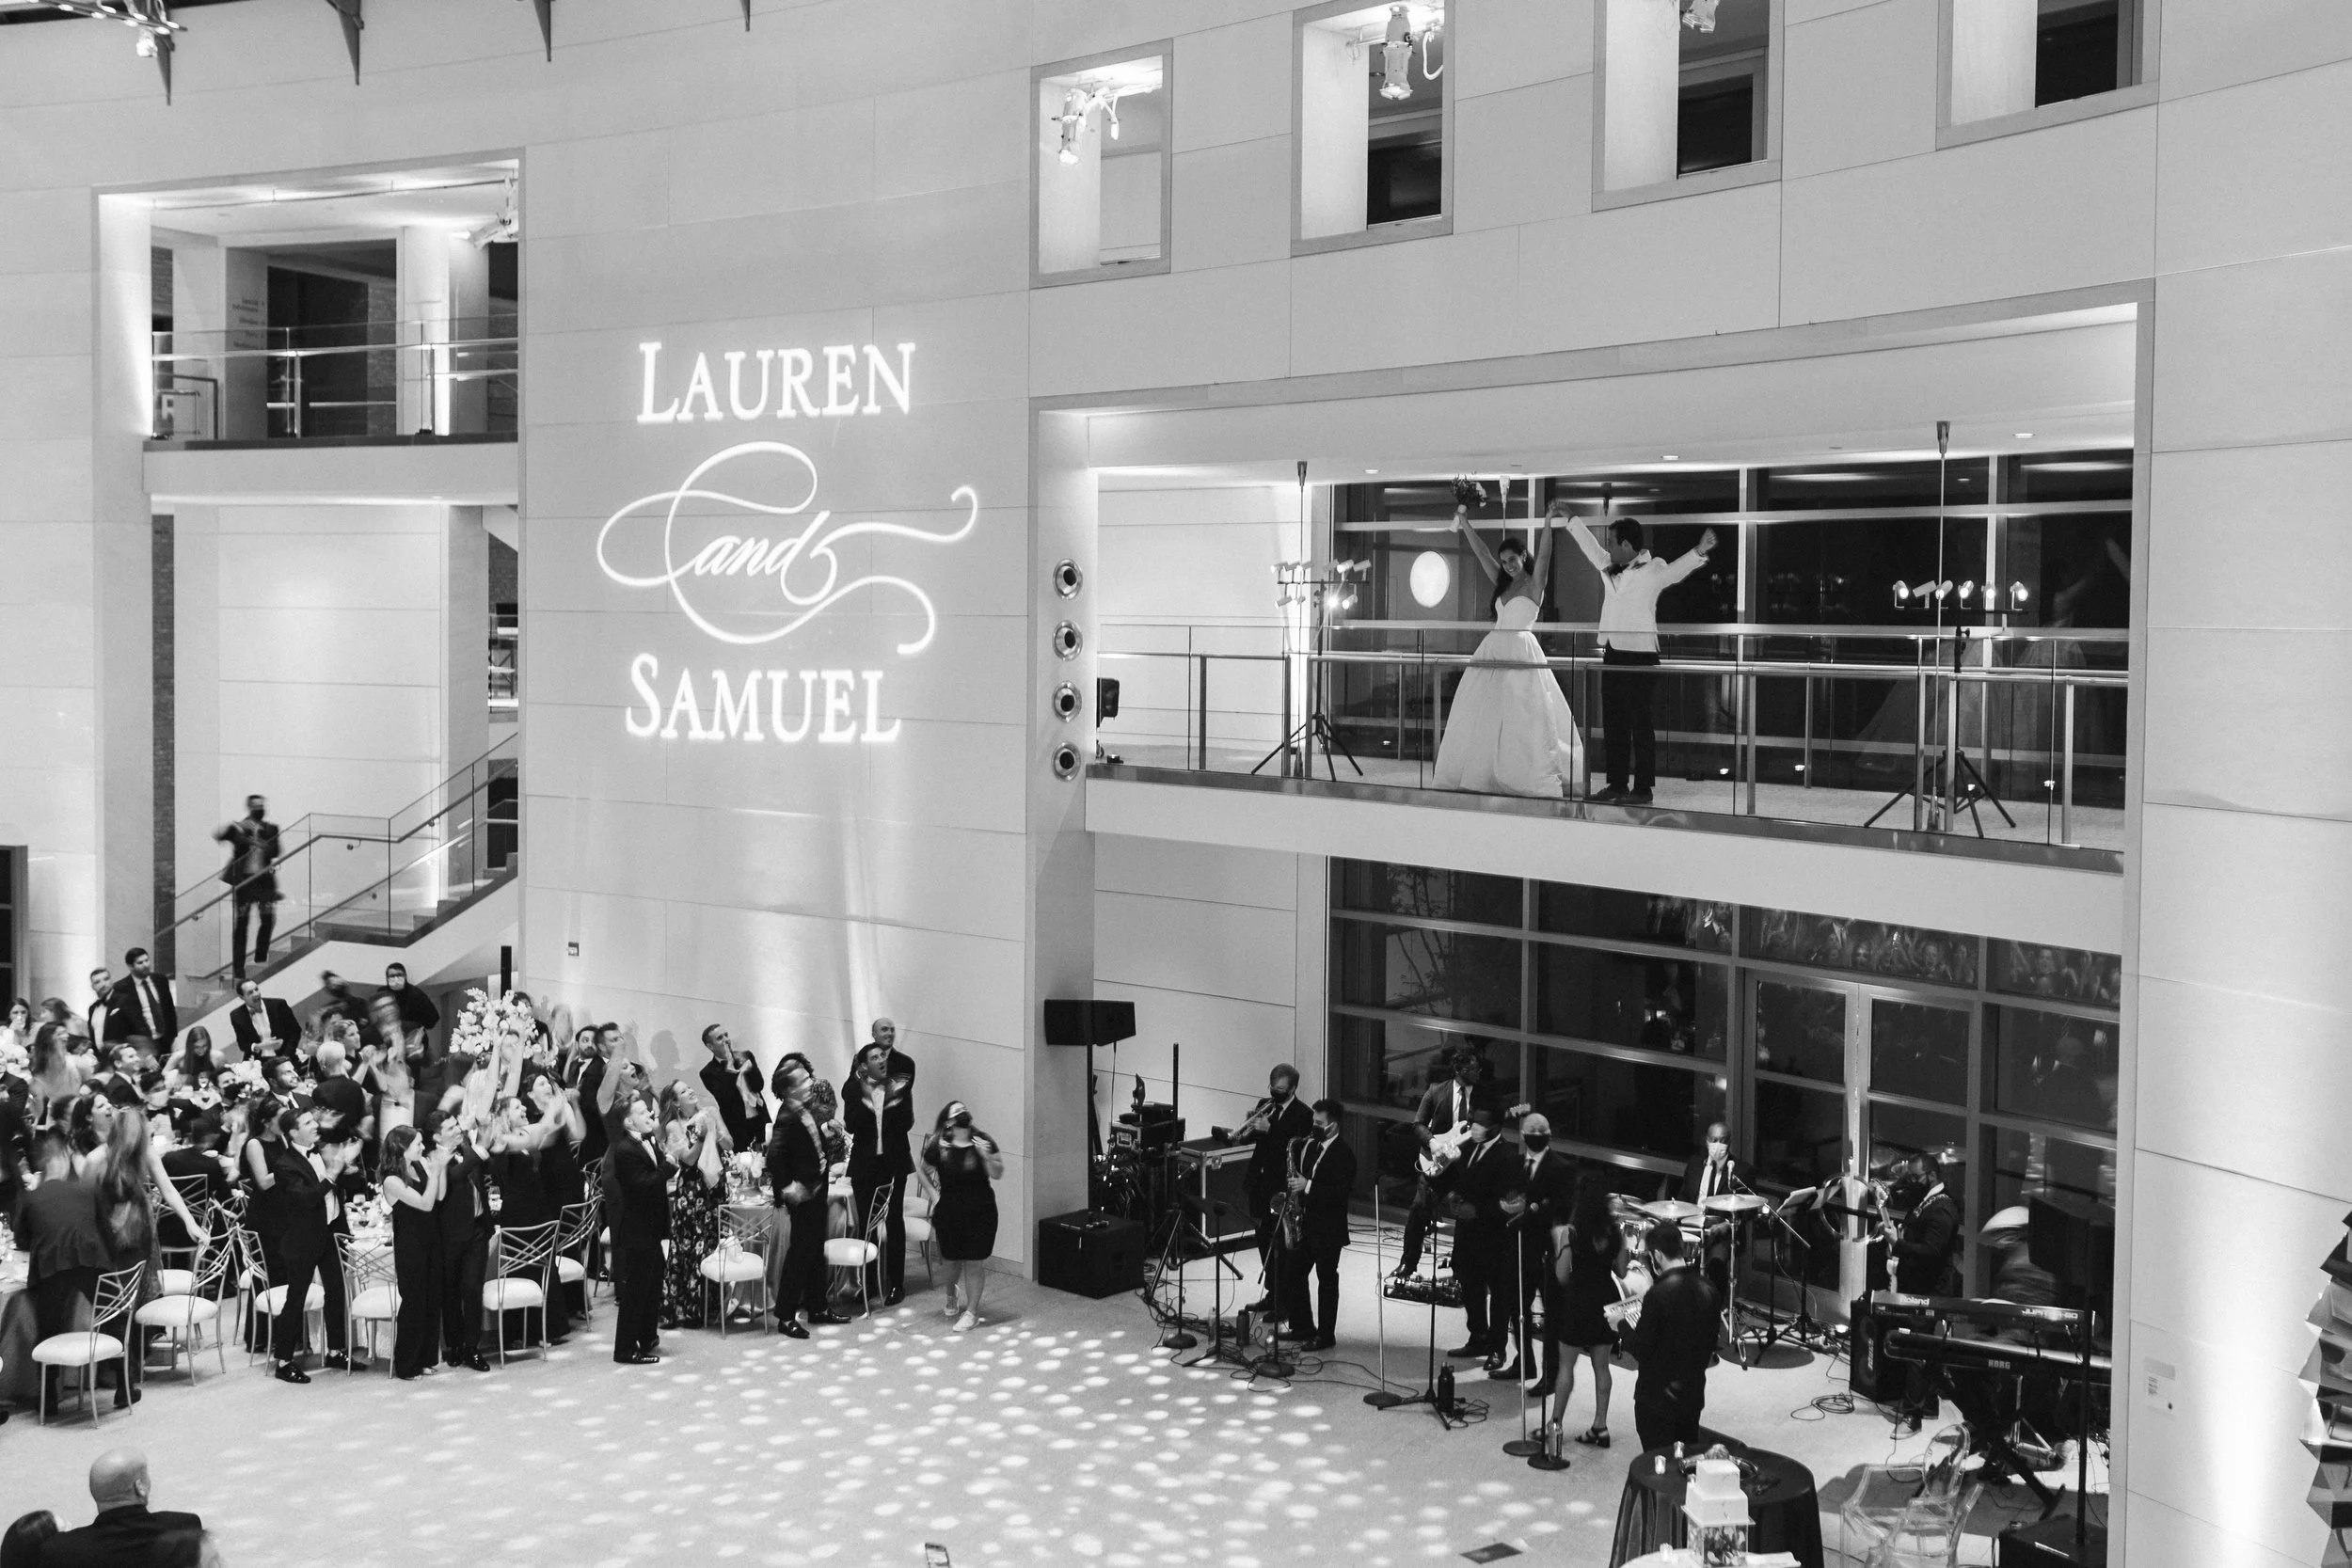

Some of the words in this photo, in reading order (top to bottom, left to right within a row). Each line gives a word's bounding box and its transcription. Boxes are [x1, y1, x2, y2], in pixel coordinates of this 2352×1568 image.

[636, 341, 916, 424] LAUREN
[625, 652, 902, 743] SAMUEL
[1988, 1359, 2010, 1370] KORG
